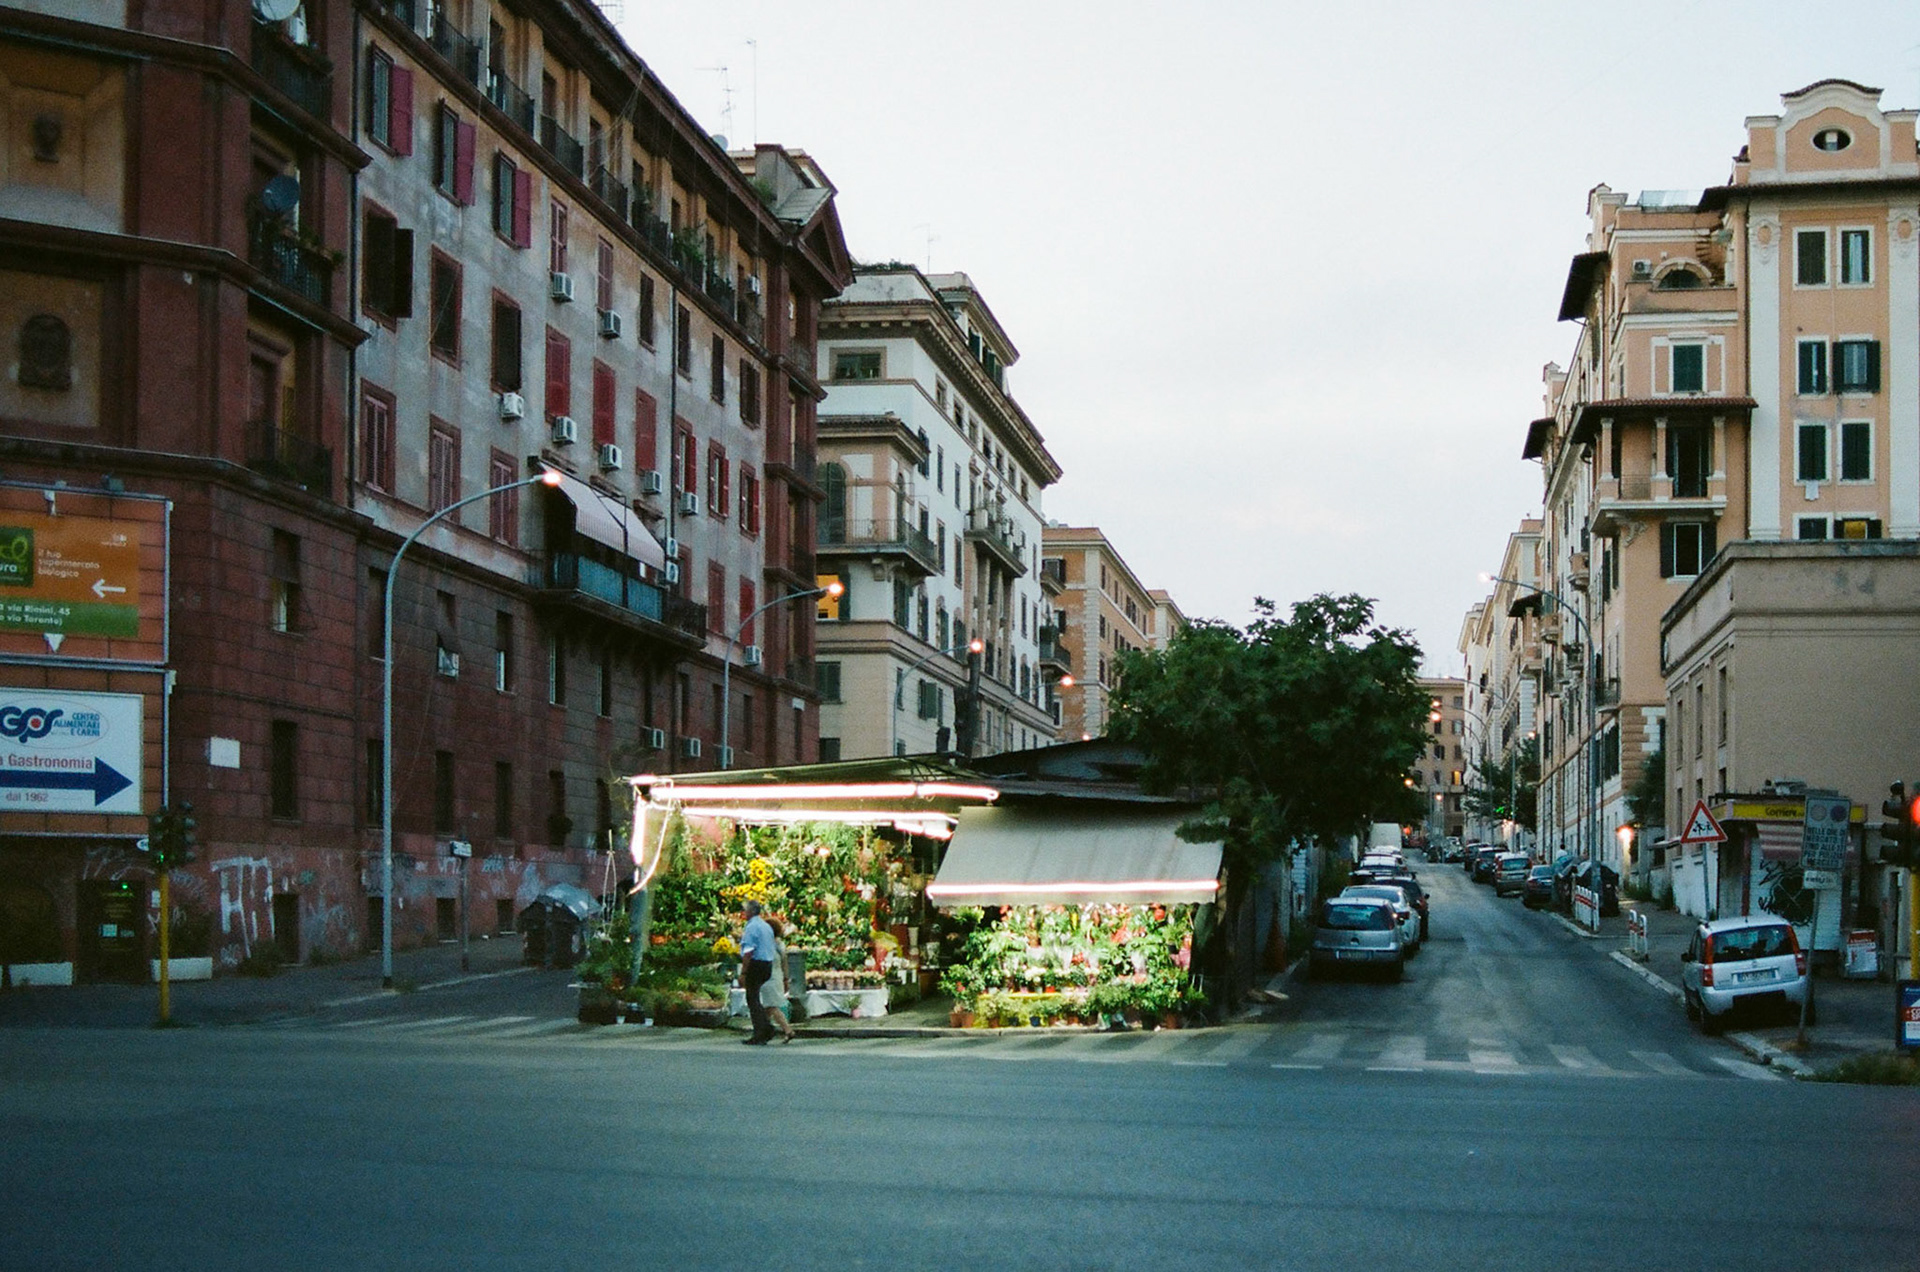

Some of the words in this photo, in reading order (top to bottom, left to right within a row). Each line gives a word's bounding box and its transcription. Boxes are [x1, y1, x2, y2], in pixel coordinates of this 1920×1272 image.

[38, 558, 100, 569] supermercato
[38, 567, 80, 578] biologico
[7, 604, 22, 612] via
[24, 604, 56, 616] Rimini,
[58, 608, 71, 616] 45
[7, 614, 22, 622] via
[72, 712, 100, 720] CENTRO
[53, 720, 100, 729] ALIMENTARI
[70, 728, 75, 736] E
[76, 728, 100, 736] CARNI
[8, 754, 93, 769] Gastronomia
[5, 792, 21, 802] dal
